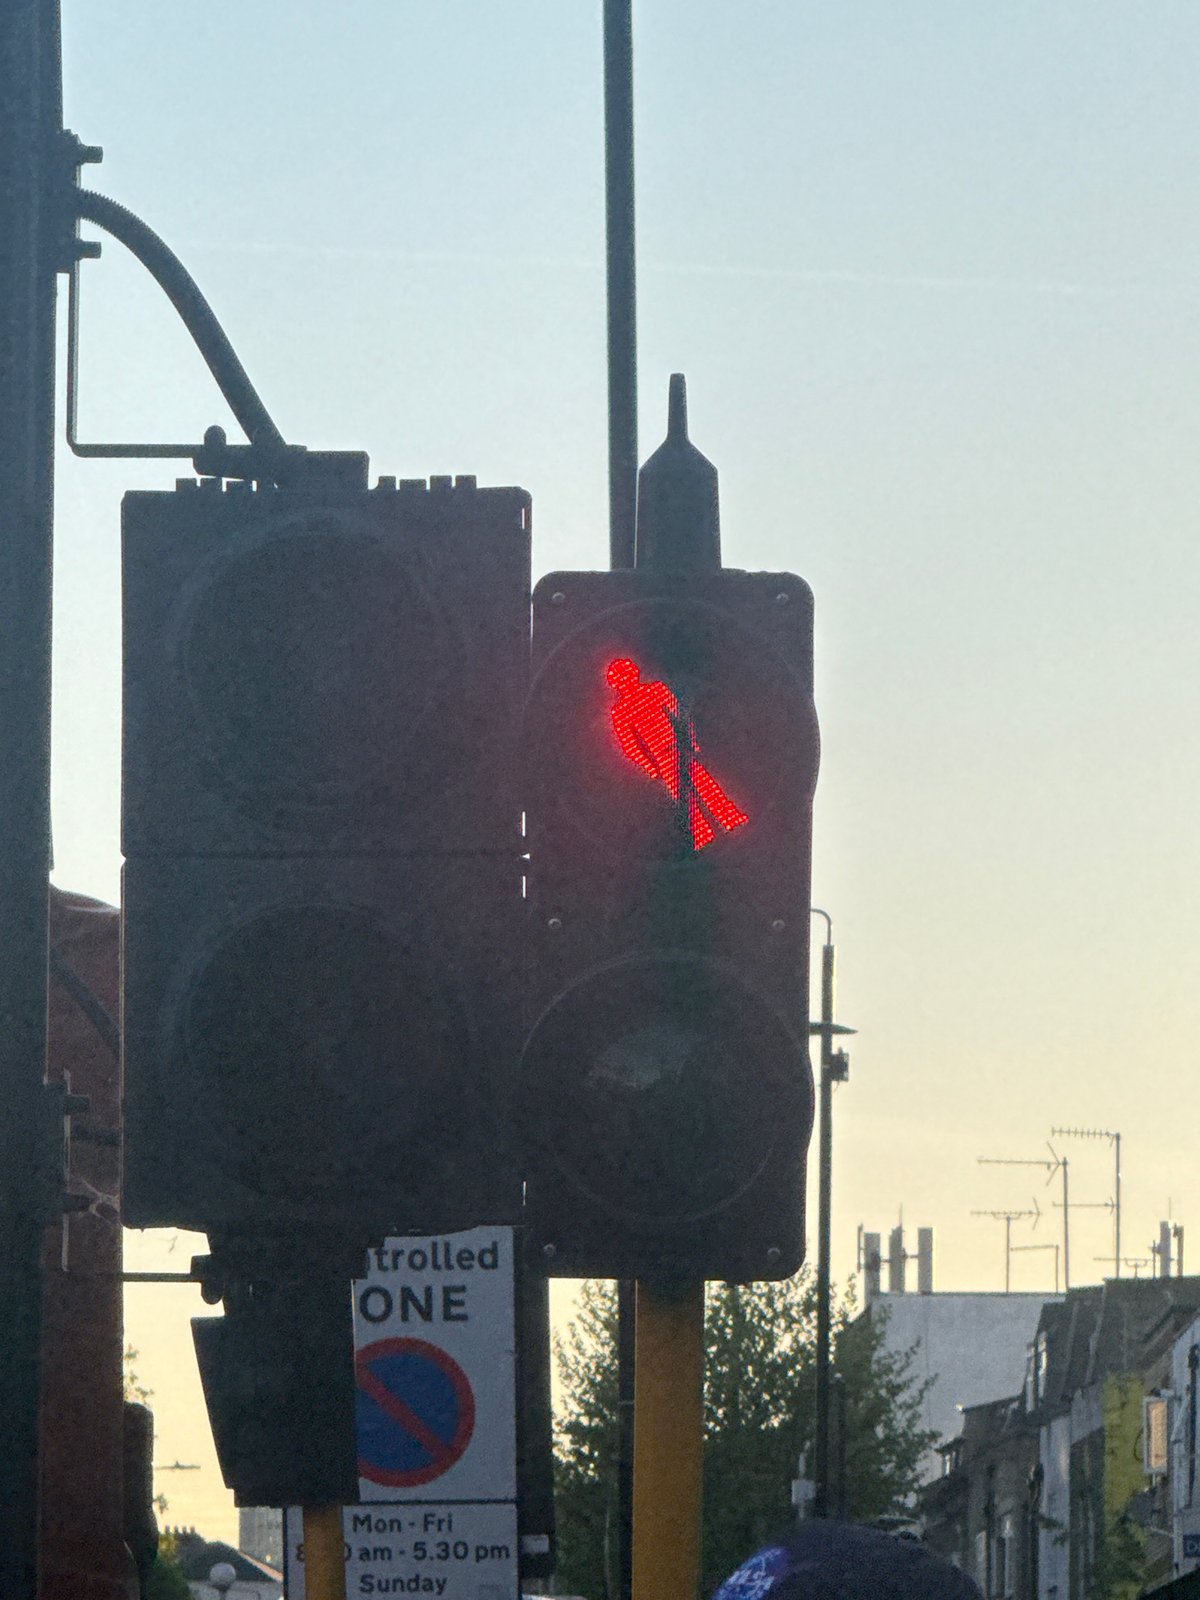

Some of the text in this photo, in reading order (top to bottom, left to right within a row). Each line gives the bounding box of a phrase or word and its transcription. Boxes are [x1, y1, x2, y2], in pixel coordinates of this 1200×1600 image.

[367, 1241, 499, 1271] trolled
[352, 1514, 402, 1533] Mon
[423, 1512, 453, 1532] Fri
[359, 1547, 392, 1562] am
[413, 1541, 469, 1561] 5.30
[475, 1544, 510, 1563] pm
[360, 1574, 447, 1595] Sunday
